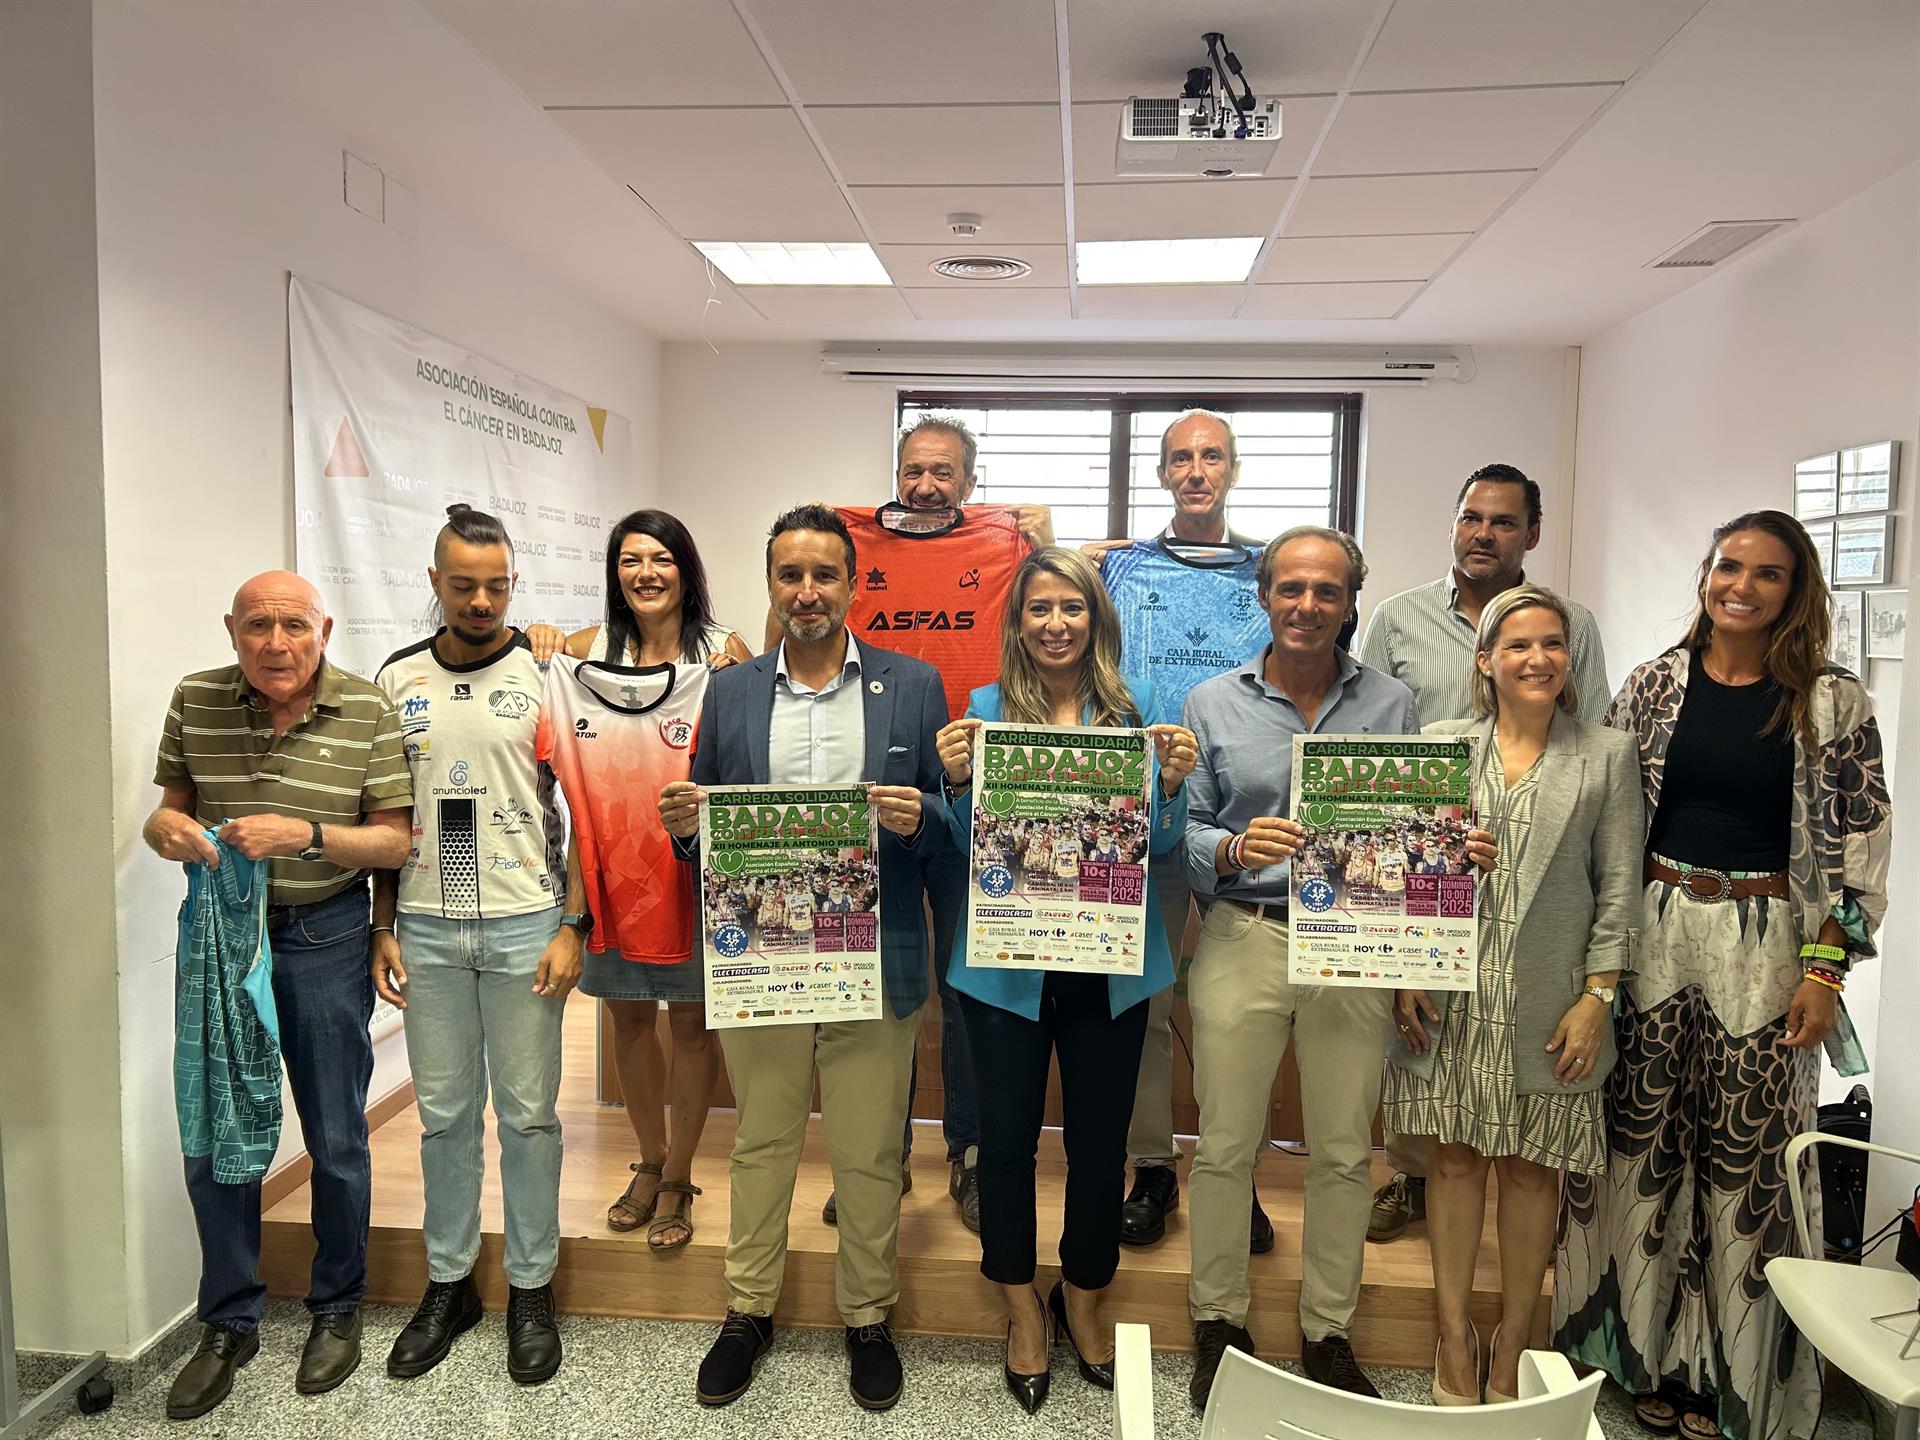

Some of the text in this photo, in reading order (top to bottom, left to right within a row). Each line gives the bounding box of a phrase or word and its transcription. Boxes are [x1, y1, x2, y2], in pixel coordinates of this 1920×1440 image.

[416, 358, 577, 434] ASOCIACIÓN ESPAÑOLA CONTRA
[444, 400, 563, 455] EL CÁNCER EN BADAJOZ
[490, 496, 526, 515] BADAJOZ
[574, 512, 600, 528] BADAJOZ
[514, 540, 547, 557] BADAJOZ
[590, 550, 606, 562] BADA
[381, 570, 428, 588] BADAJOZ
[574, 584, 600, 597] BADAJOZ
[1138, 604, 1168, 612] VIATOR
[866, 610, 976, 630] ASFAS
[1167, 648, 1225, 658] CAJA RURAL
[1148, 656, 1242, 668] DE EXTREMADURA
[988, 732, 1141, 748] CARRERA SOLIDARIA
[1306, 744, 1466, 757] CARRERA SOLIDARIA
[984, 746, 1146, 774] BADAJOZ
[984, 768, 1050, 782] CONTRA
[1054, 771, 1074, 781] EL
[1302, 758, 1471, 782] BADAJOZ
[432, 786, 487, 795] anuncioled
[1000, 783, 1051, 792] HOMENAJE
[1064, 786, 1107, 794] ANTONIO
[1110, 787, 1140, 796] PÉREZ
[1301, 781, 1372, 793] CONTRA
[1376, 782, 1395, 792] EL
[712, 791, 864, 804] CARRERA SOLIDARIA
[1319, 795, 1373, 803] HOMENAJE
[1386, 796, 1431, 804] ANTONIO
[1435, 796, 1467, 804] PÉREZ
[709, 804, 869, 829] BADAJOZ
[710, 828, 776, 840] CONTRA
[728, 841, 780, 849] HOMENAJE
[838, 838, 868, 846] PÉREZ
[1083, 866, 1106, 877] 10€
[1113, 869, 1142, 878] DOMINGO
[1114, 878, 1134, 888] 10:00
[1302, 881, 1312, 892] CLUB
[1410, 879, 1435, 890] 10€
[1442, 881, 1472, 890] DOMINGO
[1112, 887, 1141, 901] 2025
[1443, 890, 1465, 900] 10:00
[1467, 891, 1472, 899] H
[1442, 900, 1472, 914] 2025
[816, 918, 840, 928] 10€
[848, 926, 868, 935] 10:00
[870, 926, 874, 935] H
[847, 935, 874, 948] 2025
[714, 967, 769, 977] ELECTROCASH
[768, 984, 788, 992] HOY
[814, 982, 832, 990] caser
